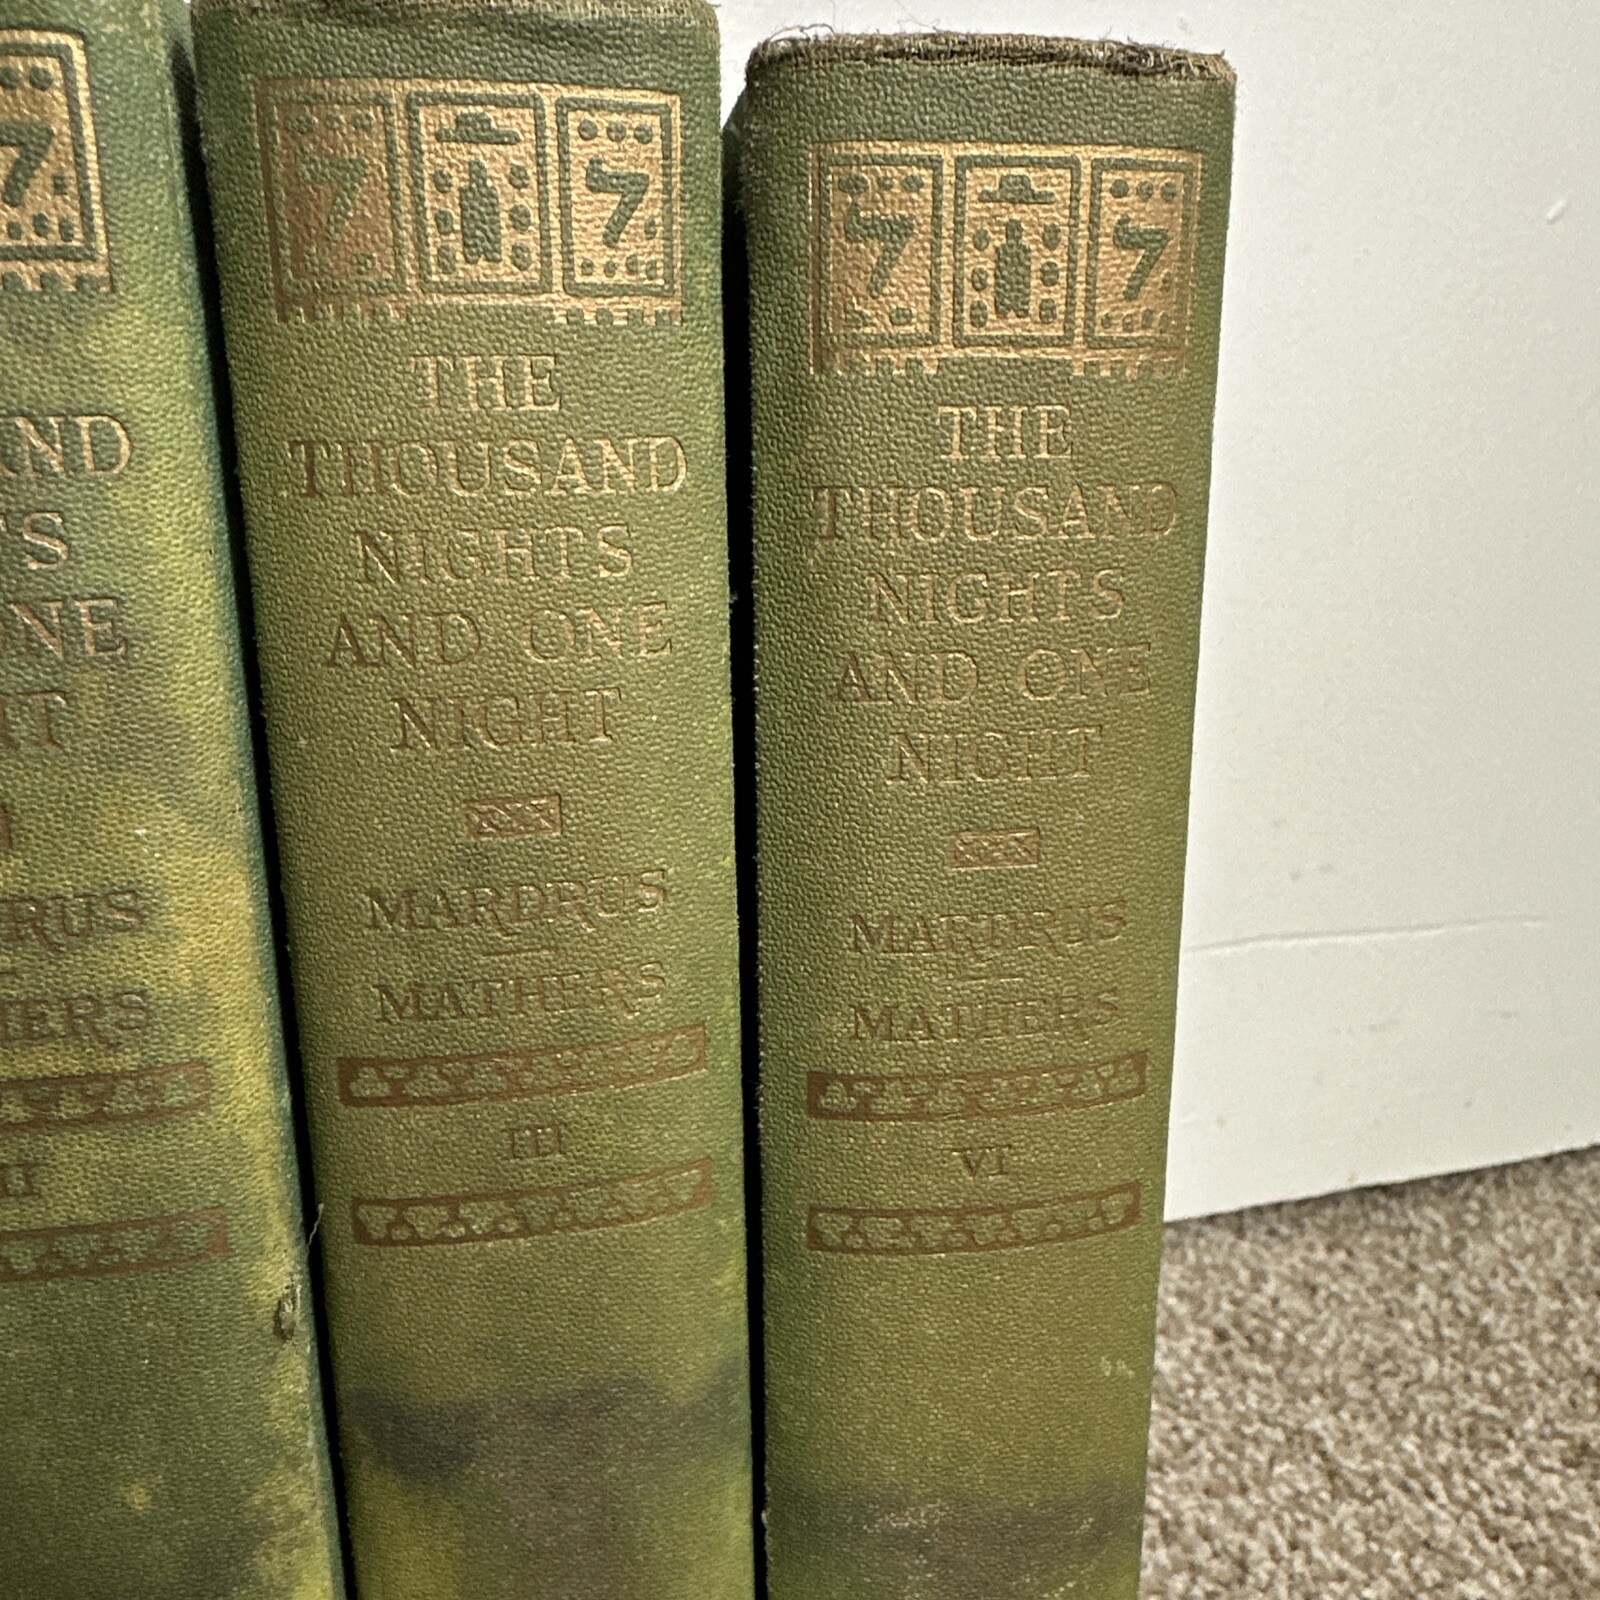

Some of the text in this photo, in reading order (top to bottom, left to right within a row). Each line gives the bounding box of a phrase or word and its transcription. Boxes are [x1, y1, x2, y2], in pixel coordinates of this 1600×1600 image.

[409, 353, 562, 412] THE
[0, 413, 133, 479] ND
[938, 405, 1074, 460] THE
[288, 434, 688, 500] THOUSAND
[810, 483, 1179, 541] THOUSAND
[353, 522, 634, 585] NIGHTS
[865, 568, 1126, 624] NIGHTS
[0, 598, 128, 661] NE
[322, 600, 673, 669] AND ONE
[827, 643, 1152, 705] AND ONE
[390, 686, 622, 751] NIGHT
[887, 724, 1103, 785] NIGHT
[361, 868, 668, 938] MARDRUS
[846, 901, 1129, 966] MARDRUS
[370, 961, 667, 1023] MATHERS
[846, 988, 1121, 1046] MATHERS
[503, 1123, 567, 1160] III
[949, 1144, 1013, 1179] VI
